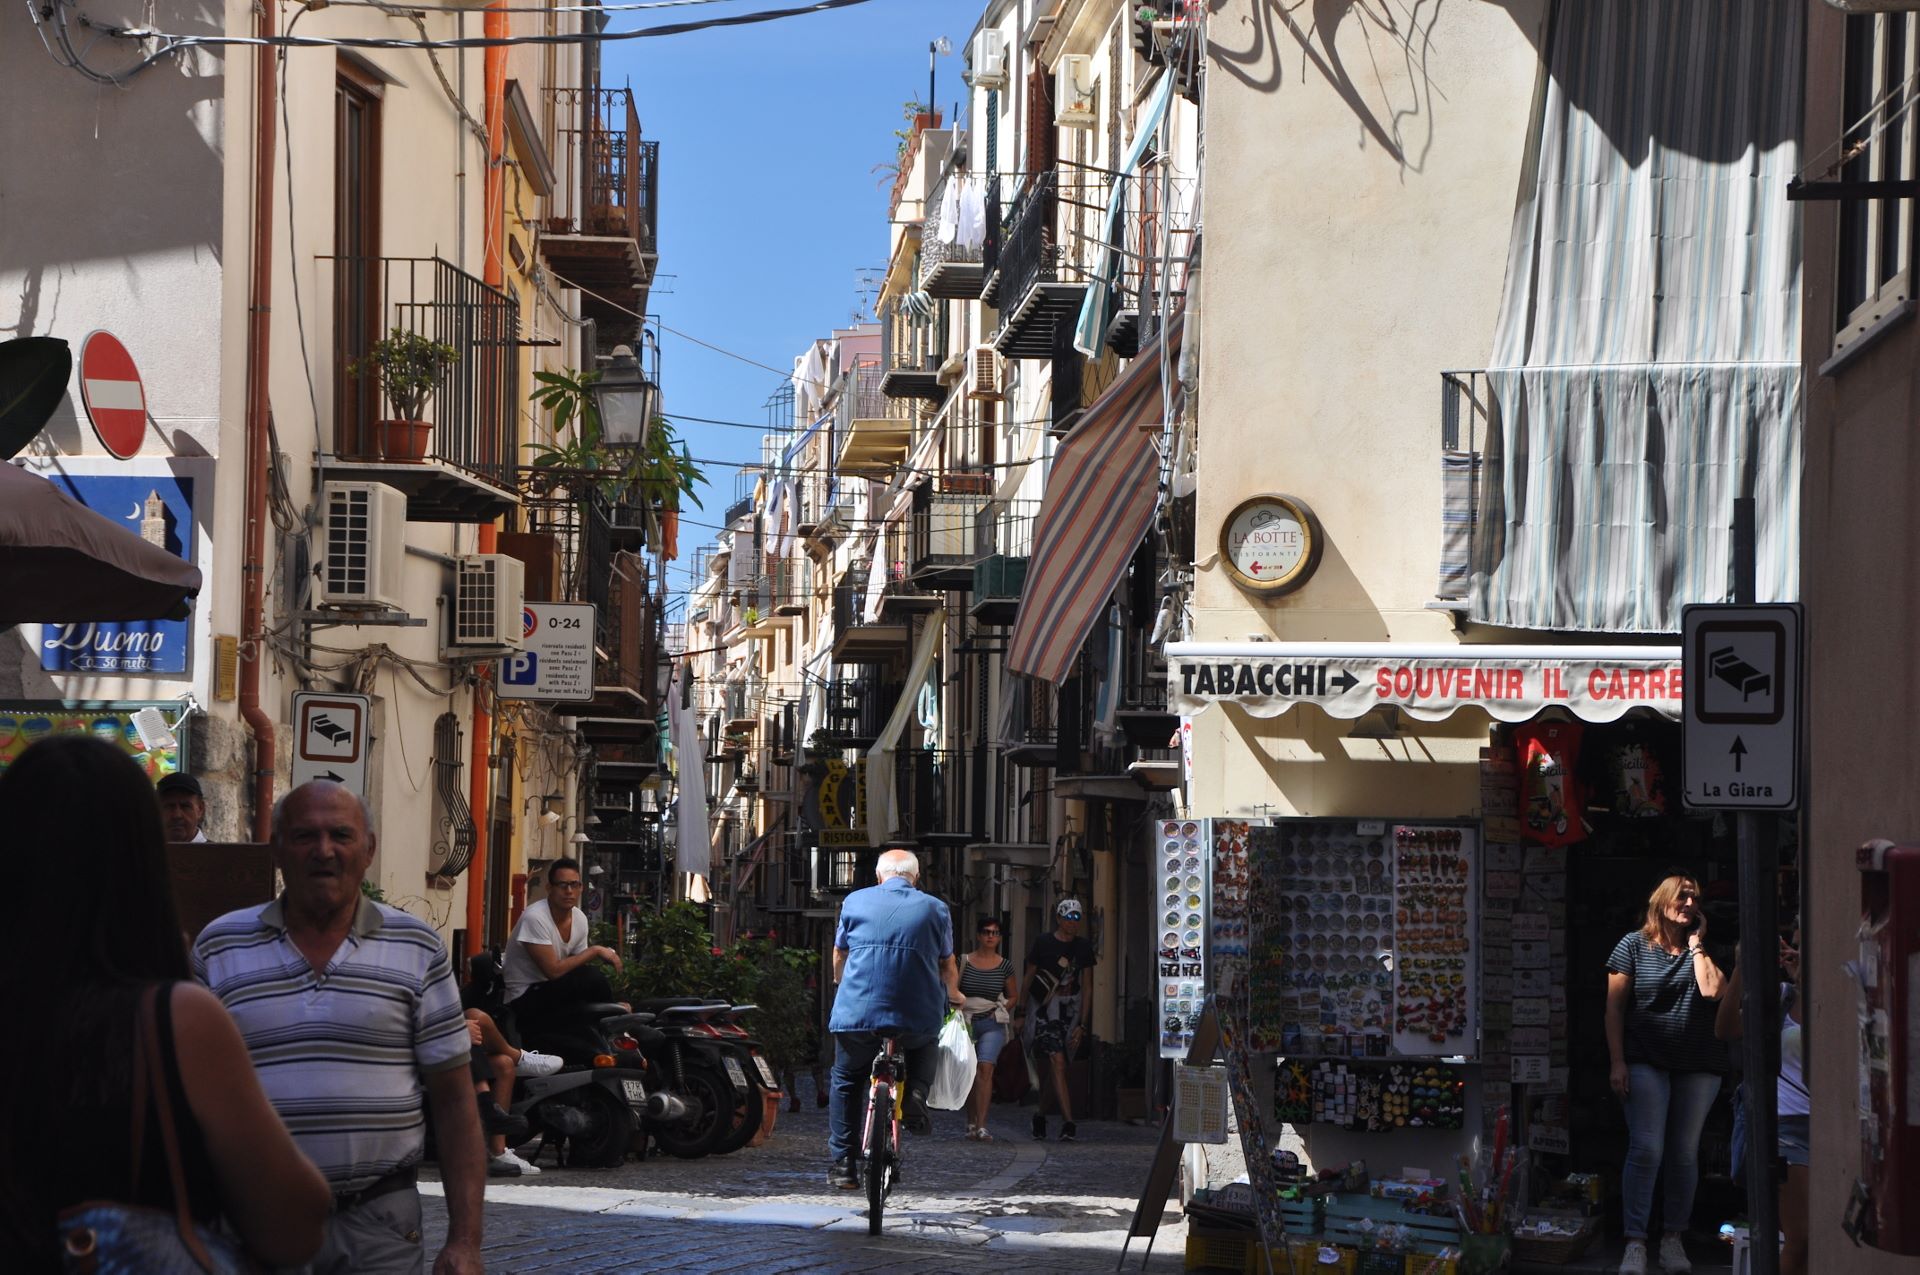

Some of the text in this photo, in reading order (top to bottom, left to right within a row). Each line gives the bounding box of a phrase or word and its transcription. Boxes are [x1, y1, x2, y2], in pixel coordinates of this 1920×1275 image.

[1234, 531, 1297, 544] LA BOTTE
[549, 617, 581, 629] 0-24
[44, 622, 165, 652] Duomo
[102, 658, 117, 668] 50
[121, 653, 151, 670] metri
[1180, 664, 1327, 696] TABACCHI
[1376, 666, 1683, 700] SOUVENIR IL CARRE
[1703, 781, 1773, 798] La Giara
